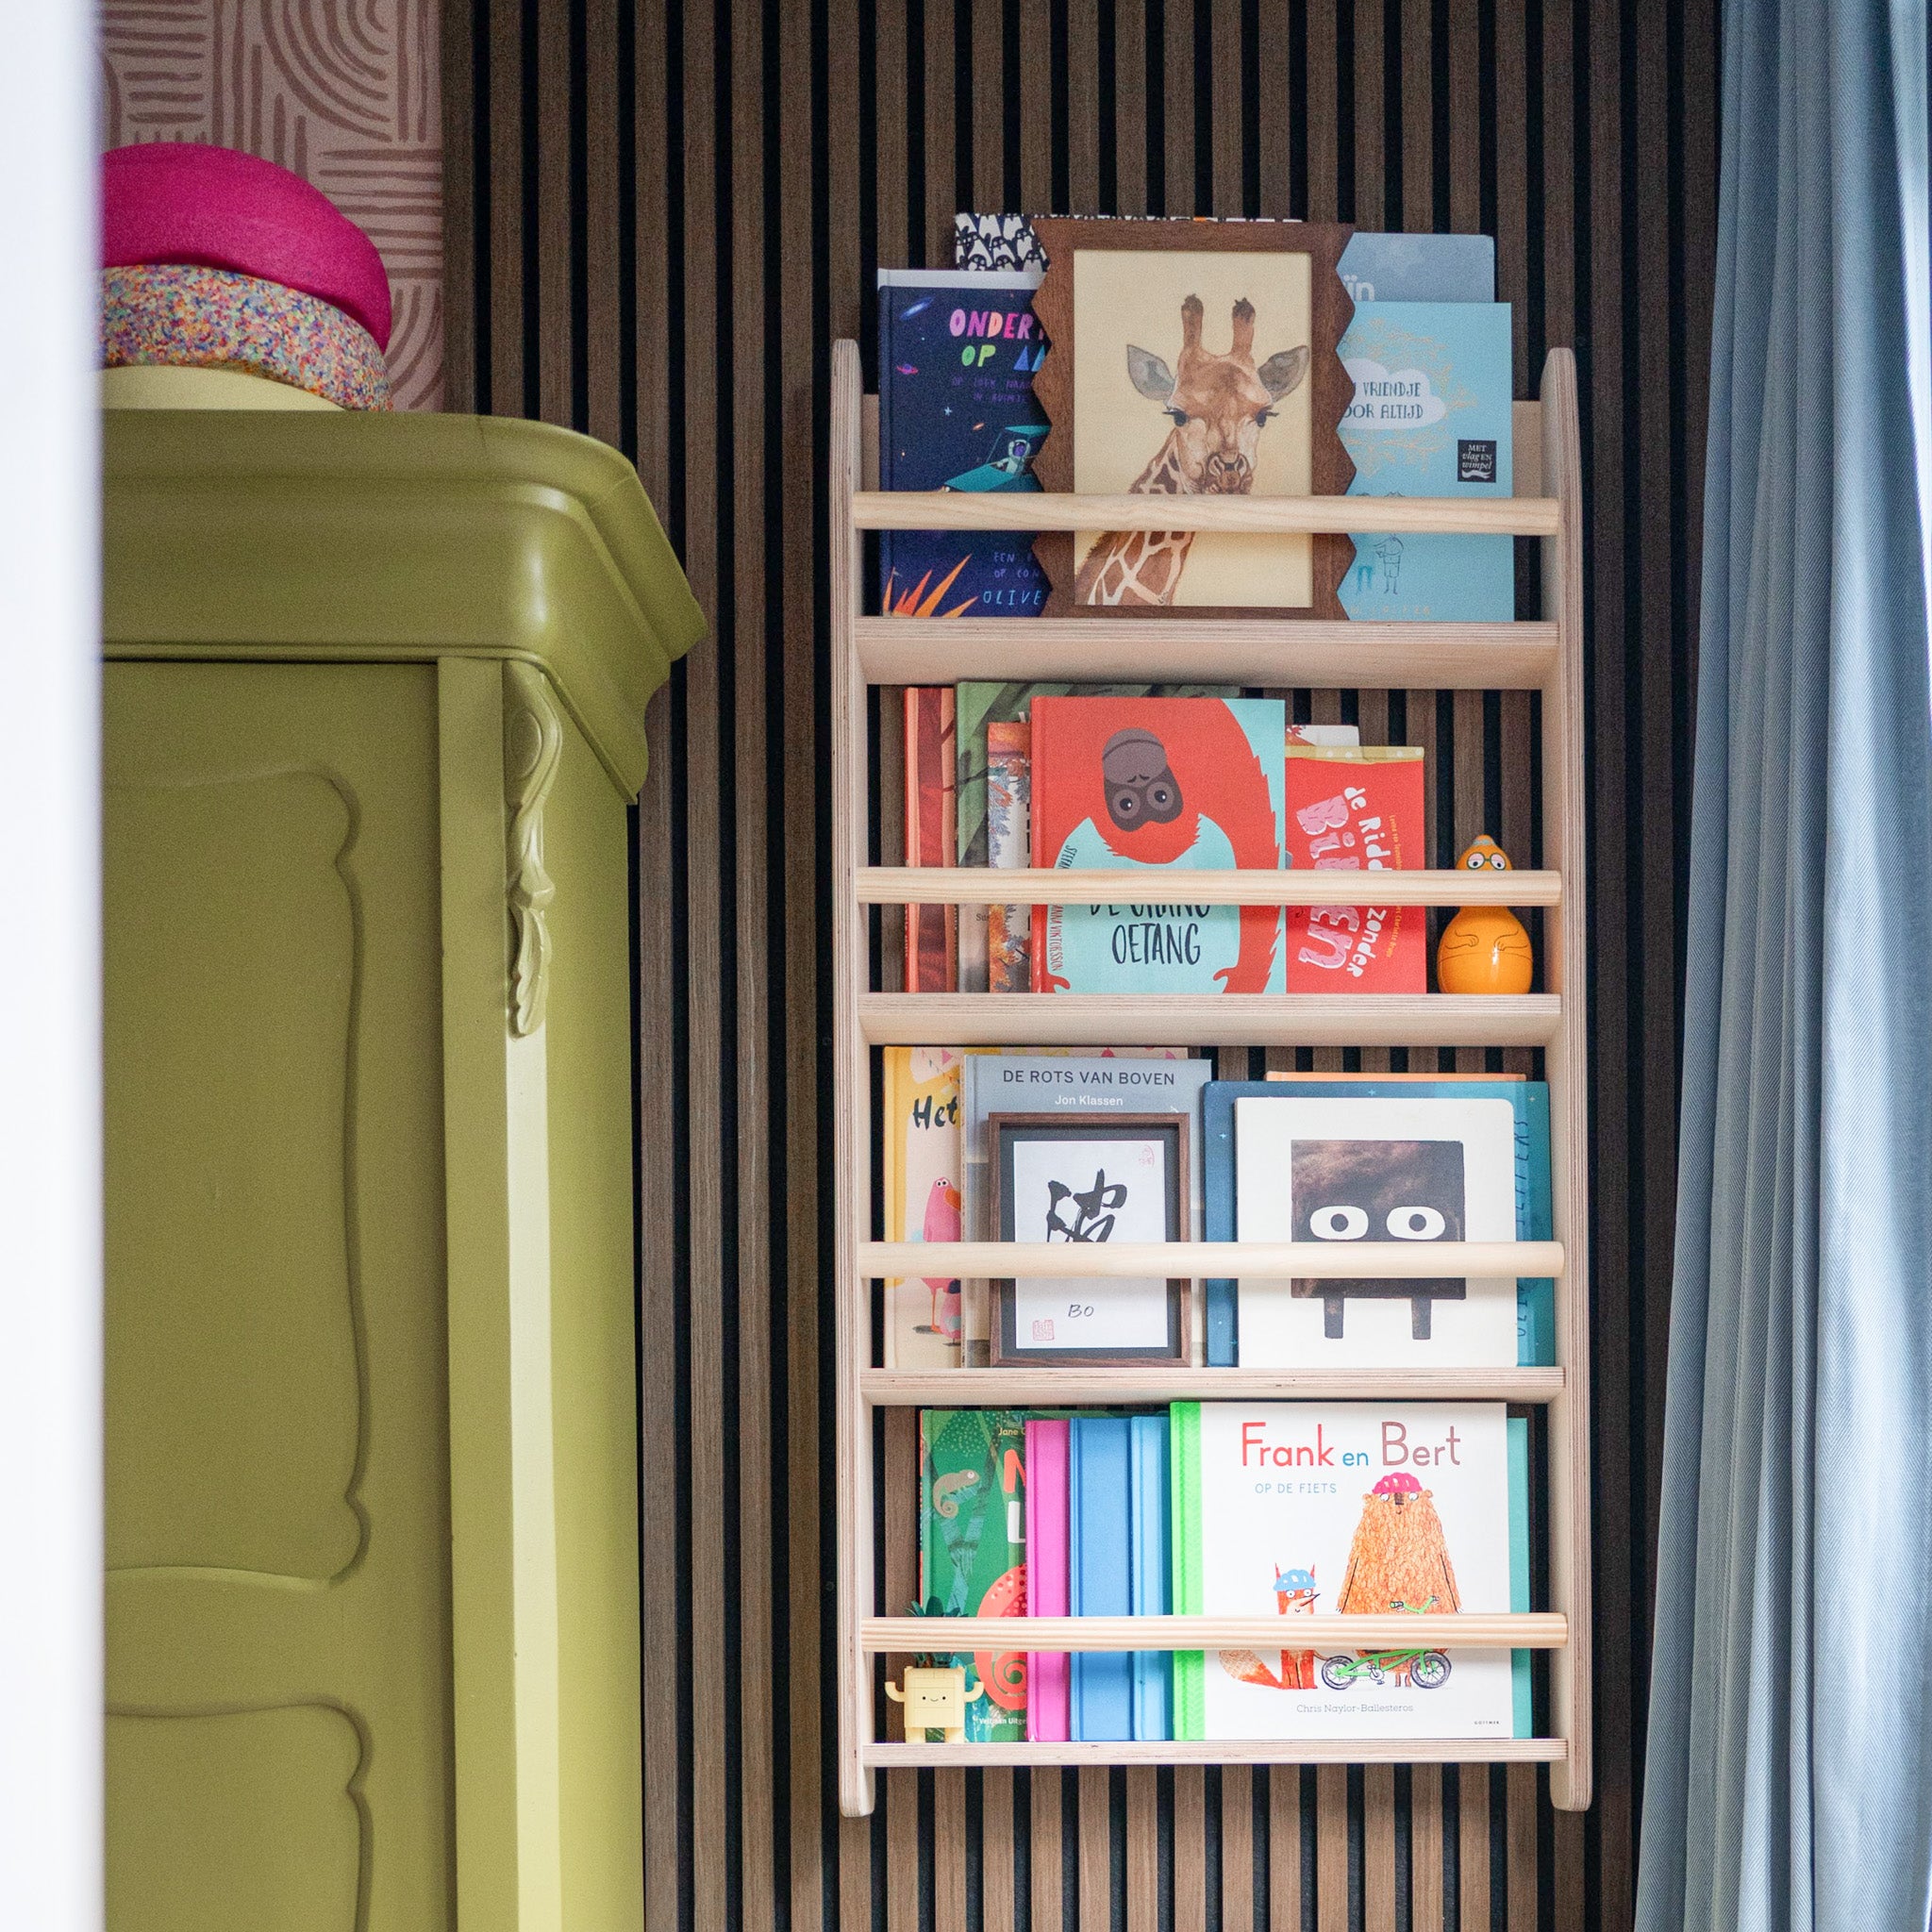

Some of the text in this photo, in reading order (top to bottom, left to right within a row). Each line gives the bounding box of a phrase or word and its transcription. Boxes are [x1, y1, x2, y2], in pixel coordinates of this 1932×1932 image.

[949, 308, 1035, 340] ONDER
[961, 344, 996, 368] OP
[1363, 381, 1422, 397] VRIENDJE
[1380, 404, 1424, 420] ALTIJD
[1343, 787, 1366, 810] de
[1111, 922, 1201, 964] OETANG
[1003, 1070, 1175, 1086] DE ROTS VAN BOVEN
[1055, 1095, 1124, 1107] Jon Klassen
[912, 1094, 958, 1131] Het
[998, 1427, 1019, 1436] Jane
[1241, 1421, 1461, 1467] Frank en Bert
[1255, 1483, 1338, 1494] OP DE FIETS
[1296, 1704, 1414, 1715] Chris Naylor-Ballesteros
